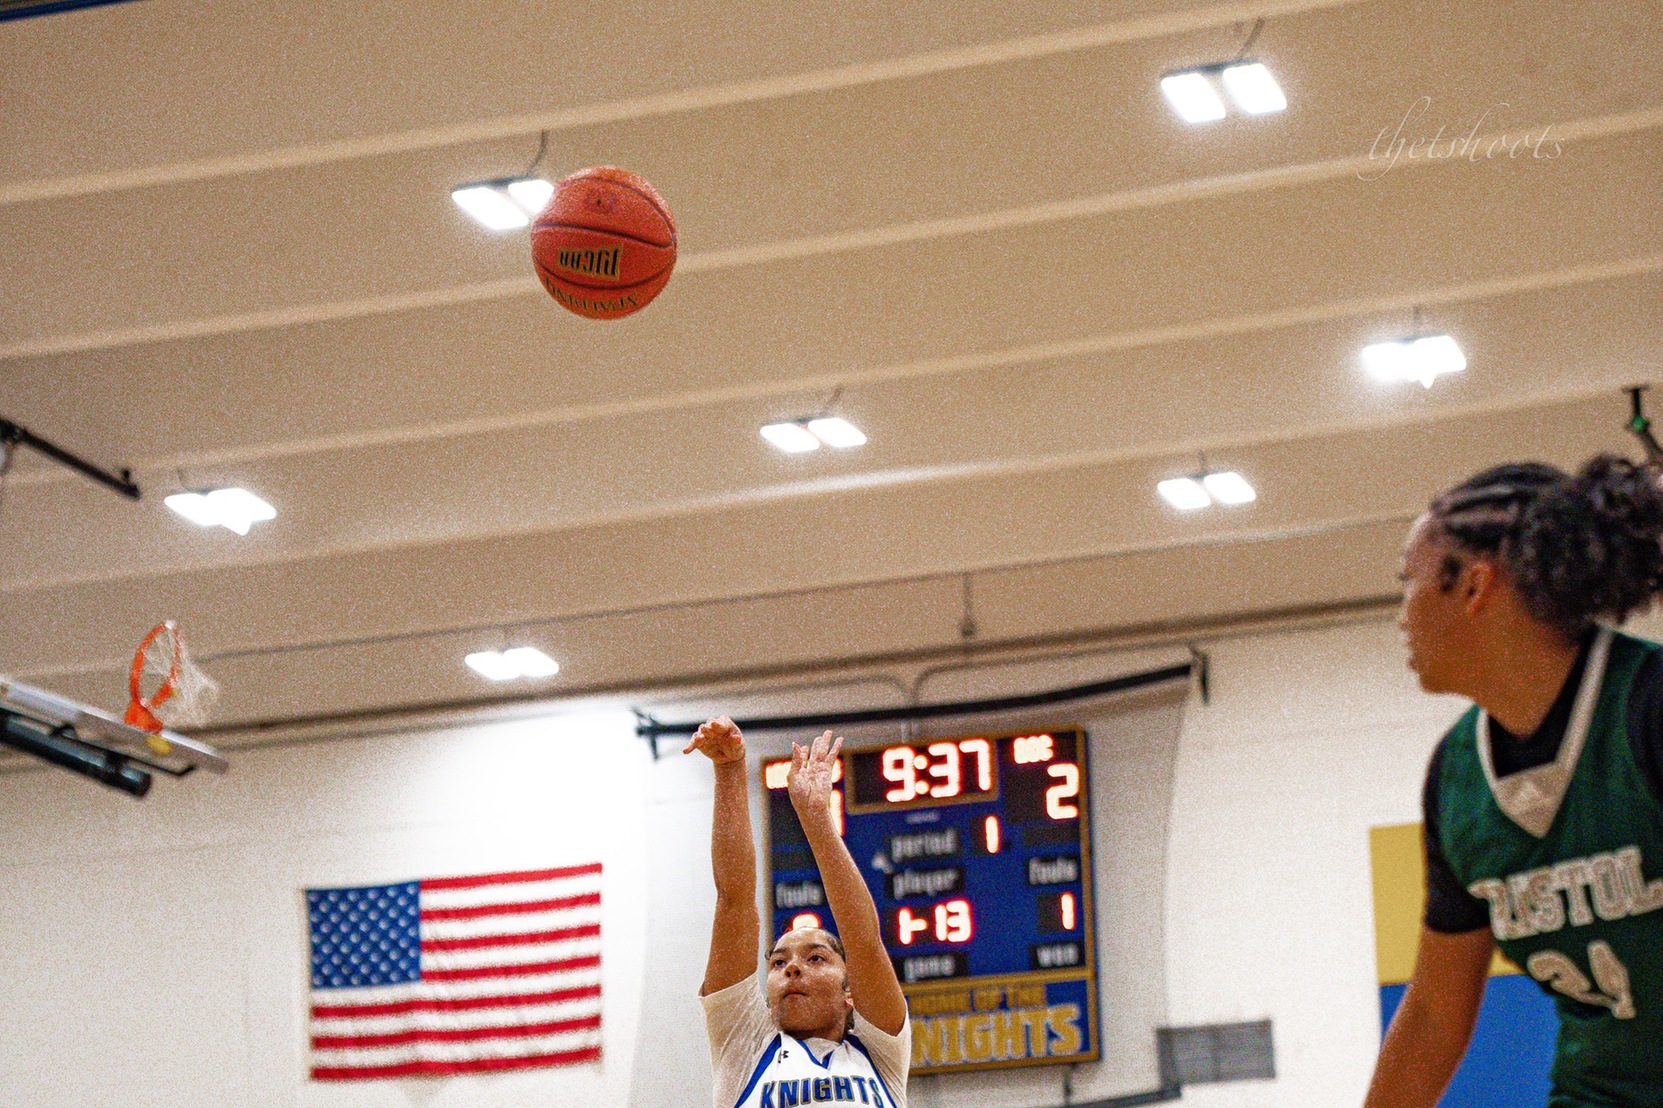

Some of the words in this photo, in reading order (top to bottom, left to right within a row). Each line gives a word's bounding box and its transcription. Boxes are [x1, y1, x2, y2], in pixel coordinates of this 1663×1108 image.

[882, 739, 991, 802] 9:37
[1046, 763, 1079, 819] 2
[985, 815, 998, 853] 1
[1061, 894, 1074, 930] 1
[907, 1002, 1083, 1068] NIGHTS
